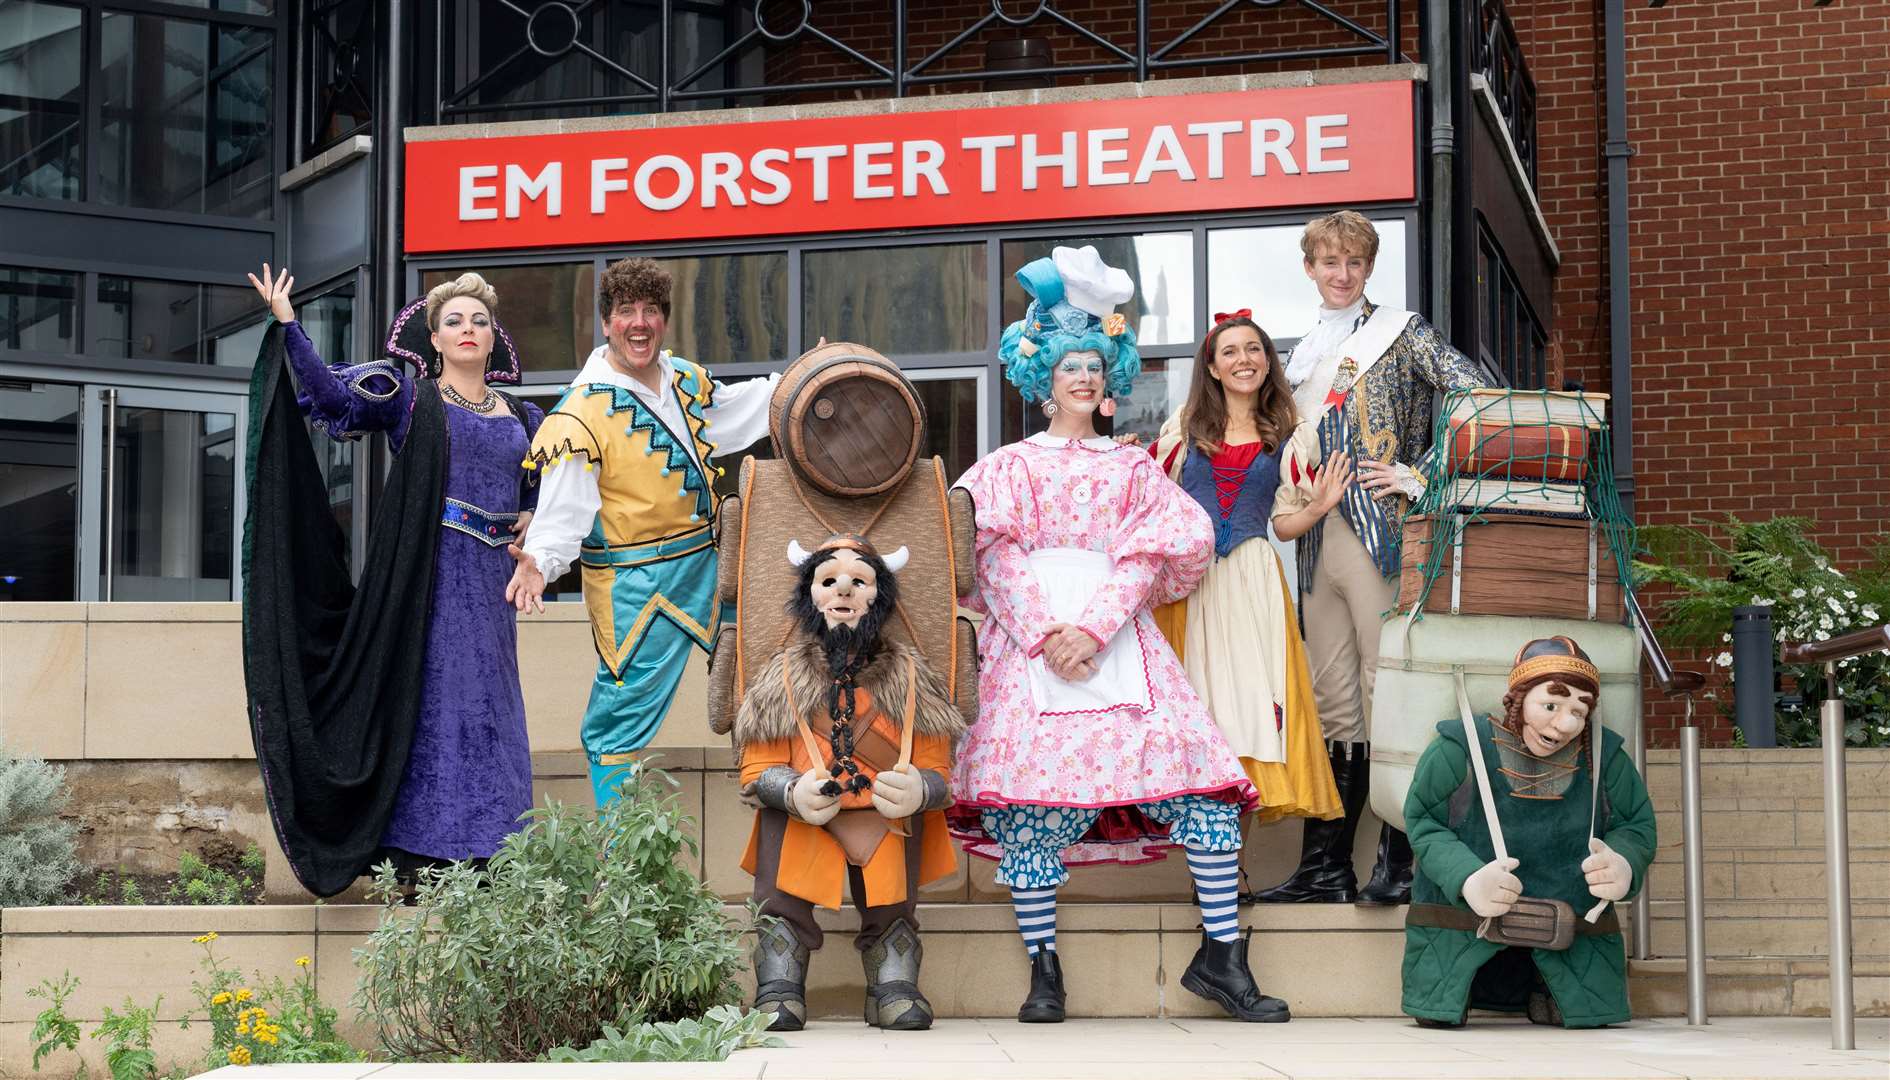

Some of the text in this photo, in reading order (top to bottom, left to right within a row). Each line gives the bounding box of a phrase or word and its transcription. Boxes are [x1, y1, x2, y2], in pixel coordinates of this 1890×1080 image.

[459, 114, 1350, 220] EM FORSTER THEATRE
